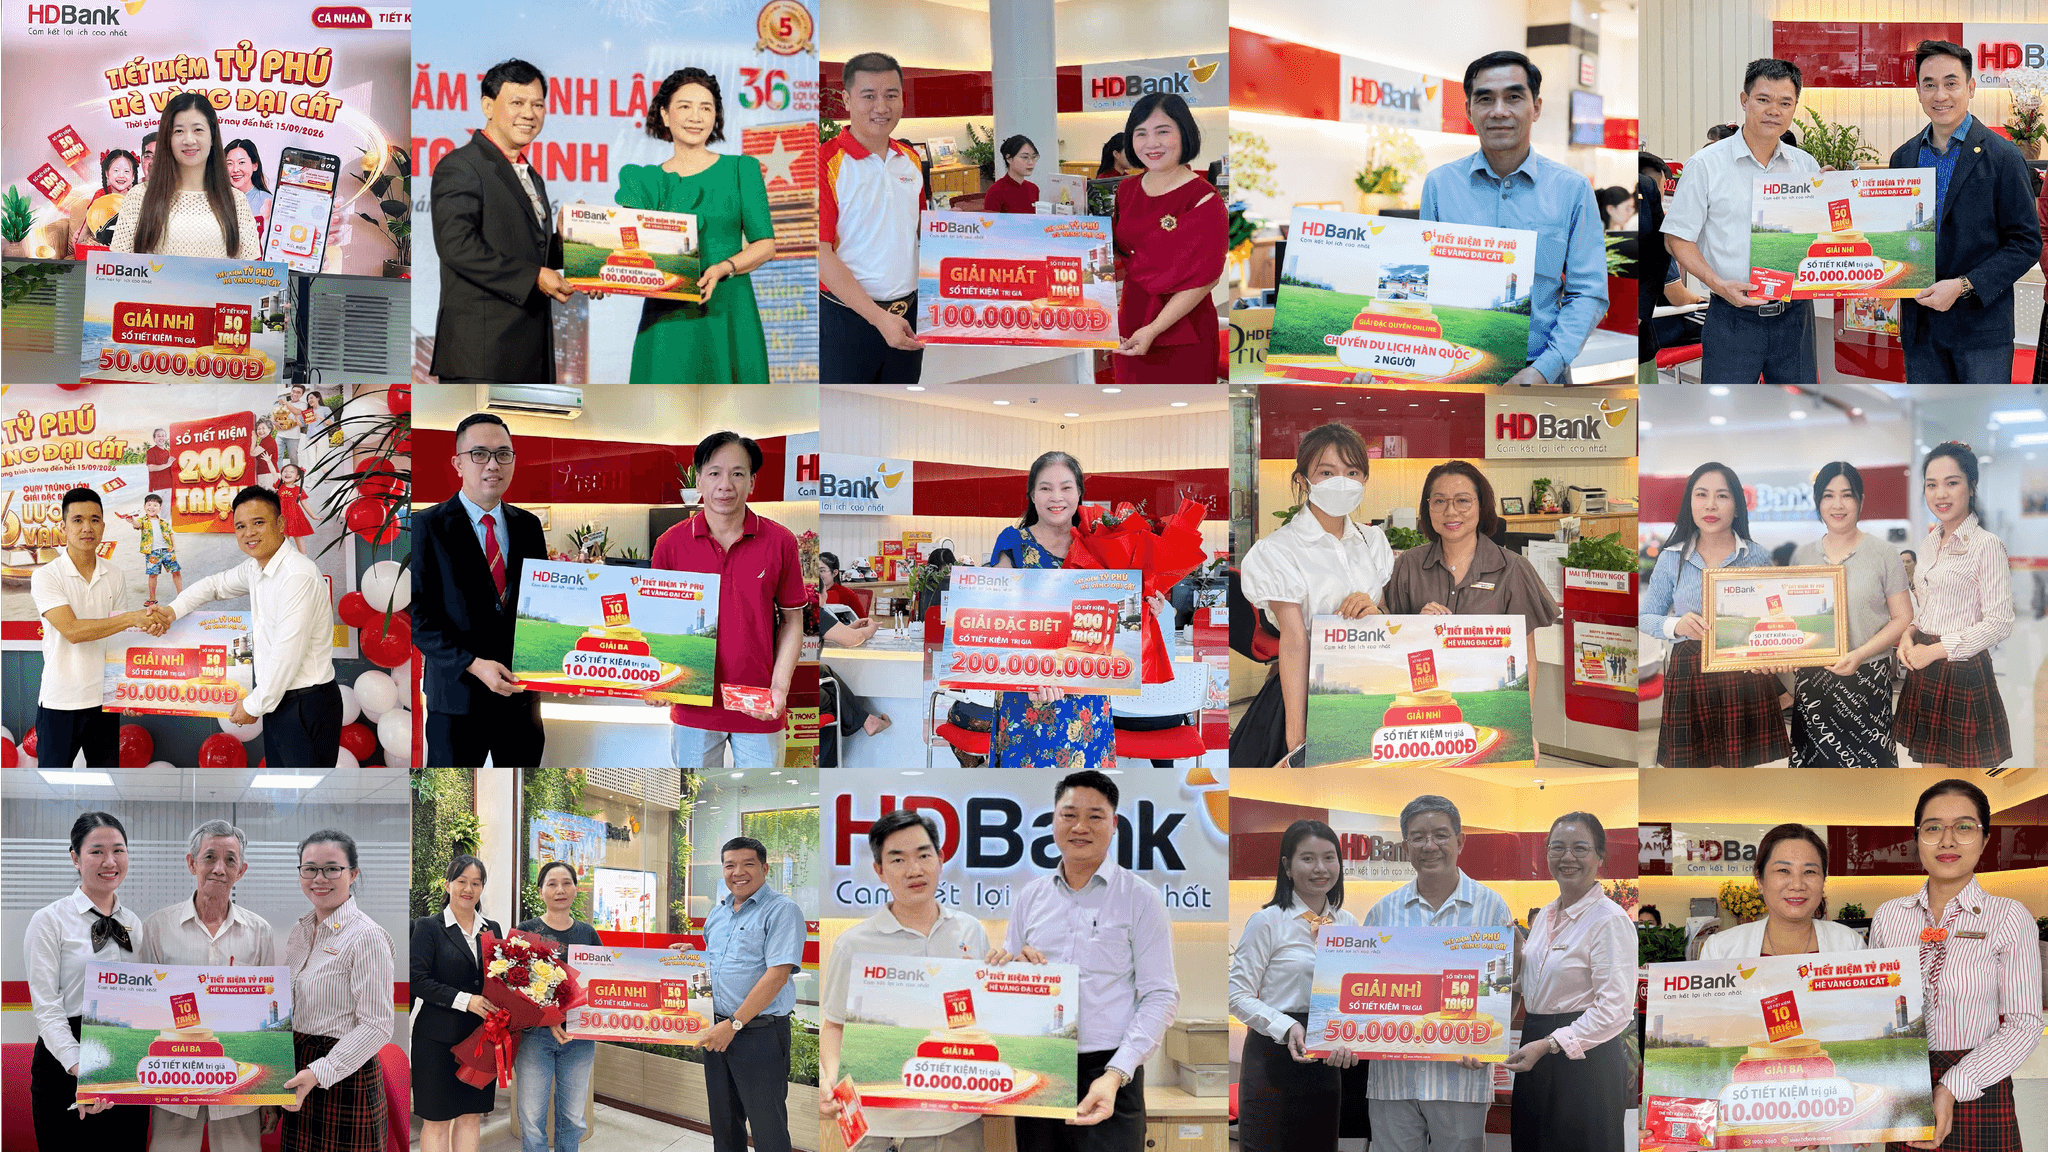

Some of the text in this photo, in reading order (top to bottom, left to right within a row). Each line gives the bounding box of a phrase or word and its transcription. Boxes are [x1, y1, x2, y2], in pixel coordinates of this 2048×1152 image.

[28, 4, 120, 26] HDBank
[317, 12, 365, 23] CÁ NHÂN
[379, 12, 401, 23] TIẾT
[28, 28, 44, 36] Cam
[779, 17, 792, 37] 5
[106, 39, 332, 90] TIẾT KIỆM TỶ PHÚ
[739, 67, 790, 111] 36
[1092, 71, 1189, 98] HDBank
[610, 73, 662, 128] LẬ
[1352, 76, 1422, 113] HDBank
[109, 89, 343, 123] HÈ ĐẠI CÁT
[224, 118, 324, 138] nay đến hết 15/09/2026
[1763, 183, 1810, 194] HDBank
[572, 209, 607, 221] HDBank
[930, 221, 980, 234] HDBank
[1302, 220, 1366, 242] HDBank
[1825, 244, 1854, 254] GIẢI NHÌ
[96, 263, 148, 278] HDBank
[600, 272, 665, 286] 100.000.000Đ
[950, 263, 1037, 284] GIẢI NHẤT
[1799, 268, 1884, 283] 50.000.000Đ
[123, 308, 194, 331] GIẢI NHÌ
[224, 316, 242, 331] 50
[928, 303, 1110, 332] 100.000.000Đ
[1412, 323, 1437, 332] ONLINE
[1324, 333, 1471, 361] CHUYẾN DU LỊCH HÀN QUỐC
[98, 346, 265, 382] 50.000.000Đ
[1375, 353, 1416, 368] 2 NGƯỜI
[40, 403, 96, 438] PHÚ
[1495, 412, 1601, 441] HDBank
[175, 426, 247, 445] SỔ TIẾT KIỆM
[43, 436, 128, 463] ĐẠI CÁT
[1497, 443, 1516, 453] Cam
[1520, 443, 1534, 453] kết
[1570, 444, 1584, 453] cao
[178, 445, 246, 482] 200
[798, 487, 817, 496] Cam
[820, 474, 879, 499] Bank
[532, 570, 584, 586] HDBank
[959, 574, 1009, 588] HDBank
[1724, 586, 1755, 594] HDBank
[960, 613, 1061, 635] GIẢI ĐẶC BIỆT
[1073, 610, 1103, 629] 200
[1325, 629, 1385, 642] HDBank
[1749, 637, 1804, 647] 10.000.000Đ
[599, 641, 628, 651] GIẢI BA
[133, 651, 184, 666] GIẢI NHÌ
[951, 650, 1132, 679] 200.000.000Đ
[565, 663, 660, 681] 10.000.000Đ
[1416, 662, 1430, 675] 50
[115, 682, 238, 705] 50.000.000Đ
[1407, 710, 1441, 721] GIẢI NHÌ
[1398, 730, 1417, 741] TIẾT
[1420, 729, 1442, 741] KIỆM
[1373, 739, 1477, 760] 50.000.000Đ
[1341, 833, 1411, 861] HDBan
[976, 881, 1010, 908] lợi
[1326, 936, 1376, 948] HDBank
[575, 952, 611, 962] HDBank
[864, 966, 924, 980] HDBank
[1814, 962, 1833, 976] TIẾT
[1836, 962, 1862, 975] KIỆM
[1880, 959, 1900, 971] PHÚ
[98, 972, 152, 986] HDBank
[1664, 973, 1736, 991] HDBank
[1815, 976, 1885, 990] HÈ VÀNG ĐẠI CÁT
[1351, 979, 1421, 998] GIẢI NHÌ
[578, 1011, 700, 1033] 50.000.000Đ
[1772, 1009, 1790, 1021] 10
[1324, 1019, 1491, 1044] 50.000.000Đ
[1769, 1020, 1798, 1037] TRIỆU
[171, 1044, 201, 1054] GIẢI BA
[943, 1045, 975, 1056] GIẢI BA
[138, 1070, 238, 1086] 10.000.000Đ
[1765, 1063, 1804, 1076] GIẢI BA
[904, 1072, 1013, 1092] 10.000.000Đ
[1733, 1086, 1747, 1101] SỔ
[1750, 1086, 1776, 1099] TIẾT
[1779, 1085, 1809, 1099] KIỆM
[1824, 1085, 1837, 1098] giá
[1720, 1097, 1854, 1122] 10.000.000Đ
